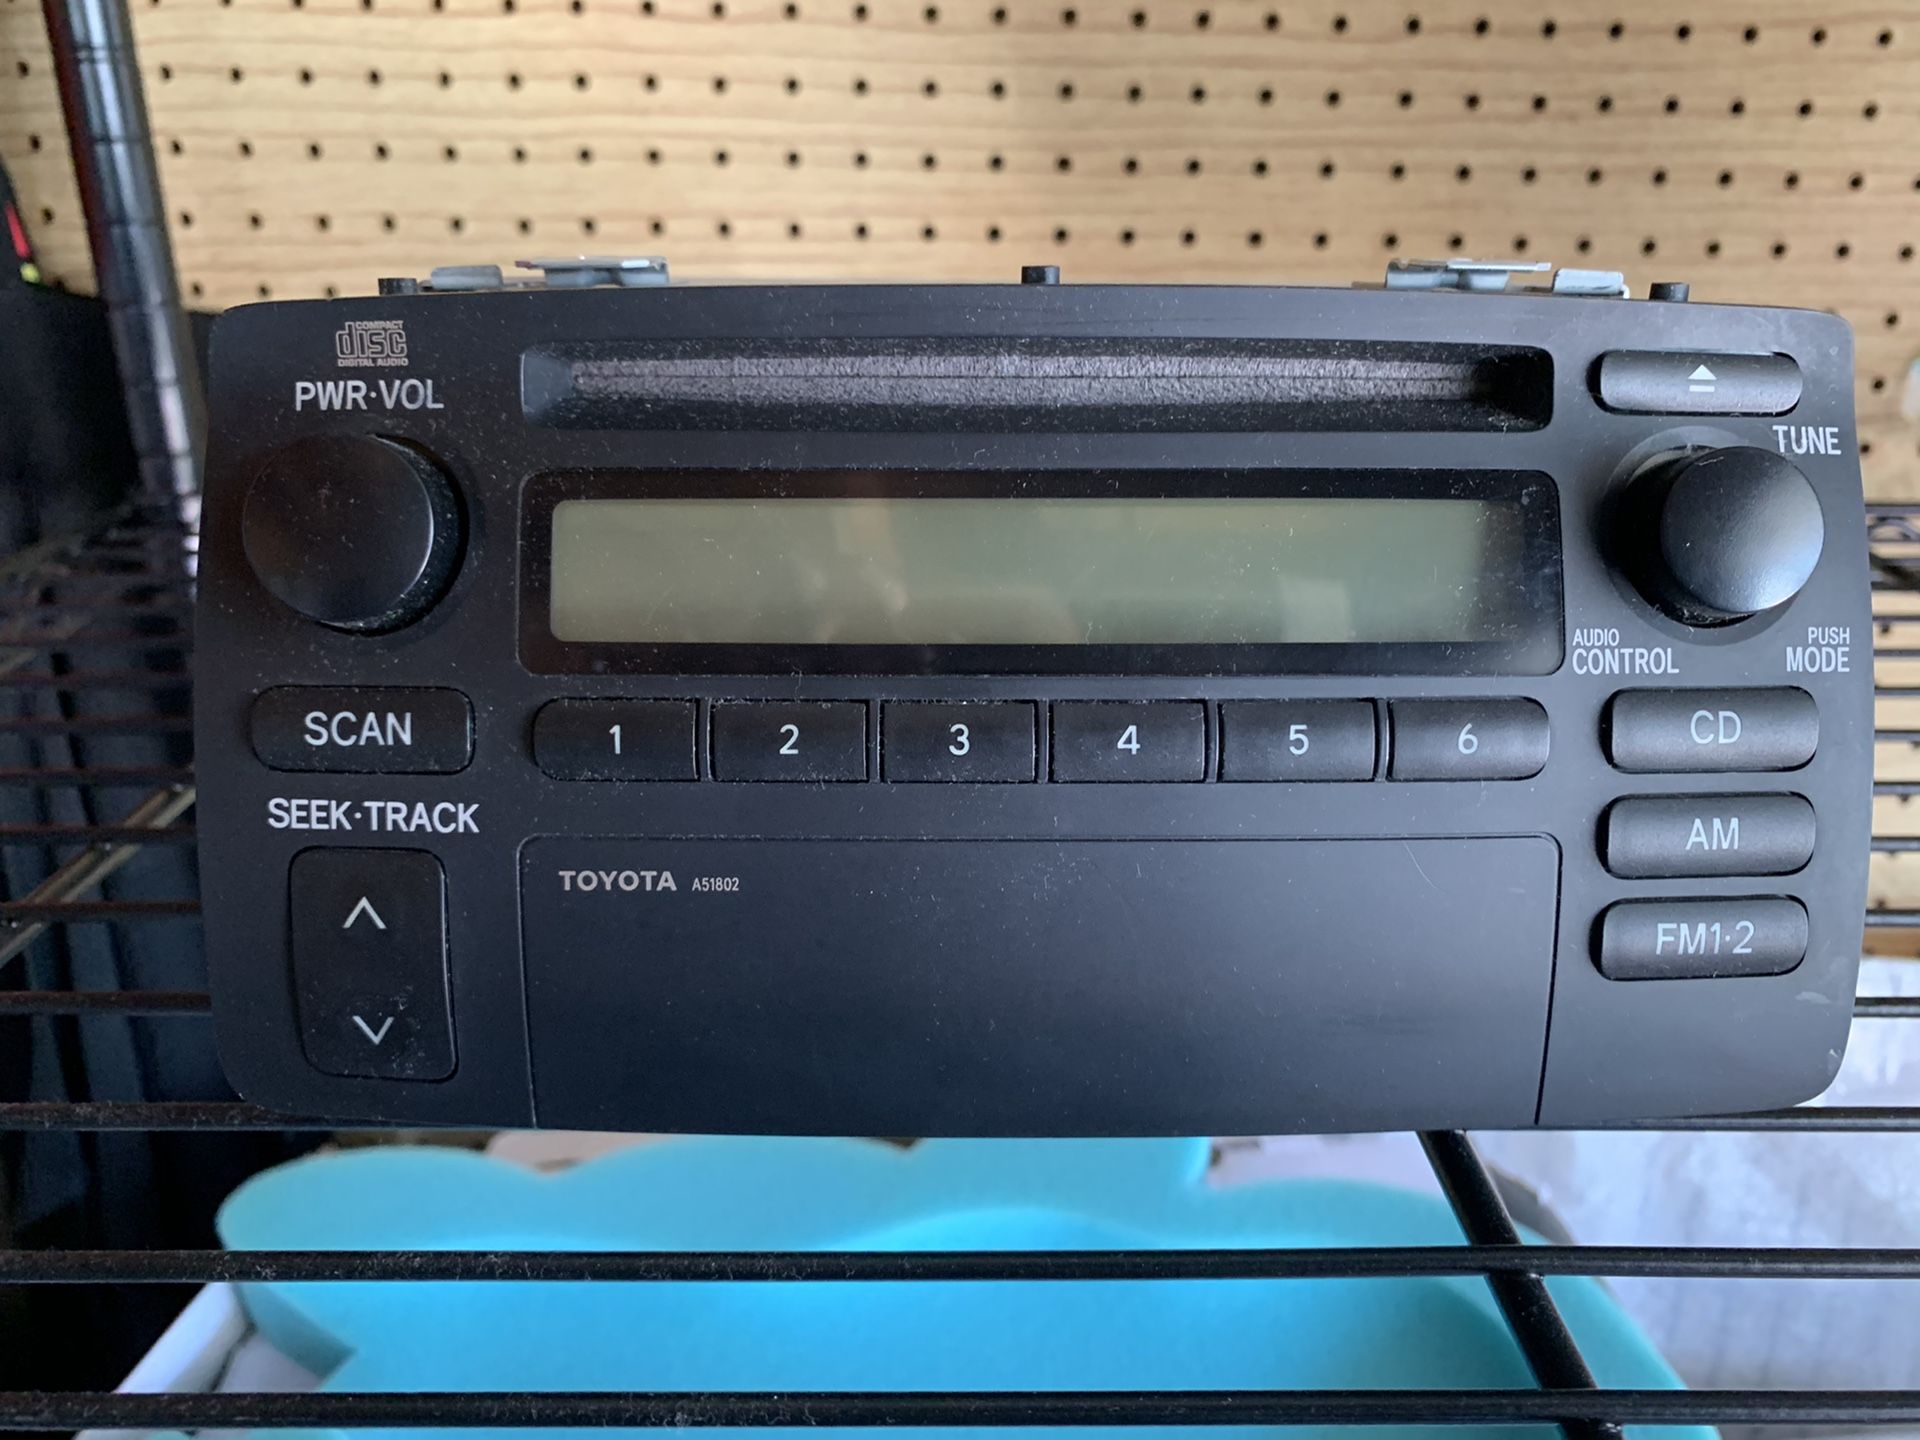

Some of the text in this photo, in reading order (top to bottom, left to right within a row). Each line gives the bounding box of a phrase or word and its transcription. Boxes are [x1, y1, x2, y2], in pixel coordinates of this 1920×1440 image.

[335, 321, 408, 358] disc
[355, 320, 403, 329] COMPACT
[337, 357, 409, 367] DIGITAL AUDIO
[1772, 424, 1842, 456] TUNE
[1572, 628, 1620, 647] AUDIO
[1807, 626, 1850, 645] PUSH
[1572, 647, 1680, 675] CONTROL
[1785, 646, 1850, 673] MODE
[303, 711, 413, 746] SCAN
[609, 724, 622, 754] 1
[778, 724, 799, 755] 2
[947, 724, 970, 755] 3
[1116, 724, 1142, 755] 4
[1286, 724, 1310, 755] 5
[1457, 723, 1478, 755] 6
[1690, 710, 1742, 745] CD
[1685, 817, 1740, 851] AM
[558, 870, 740, 892] TOYOTA A51802
